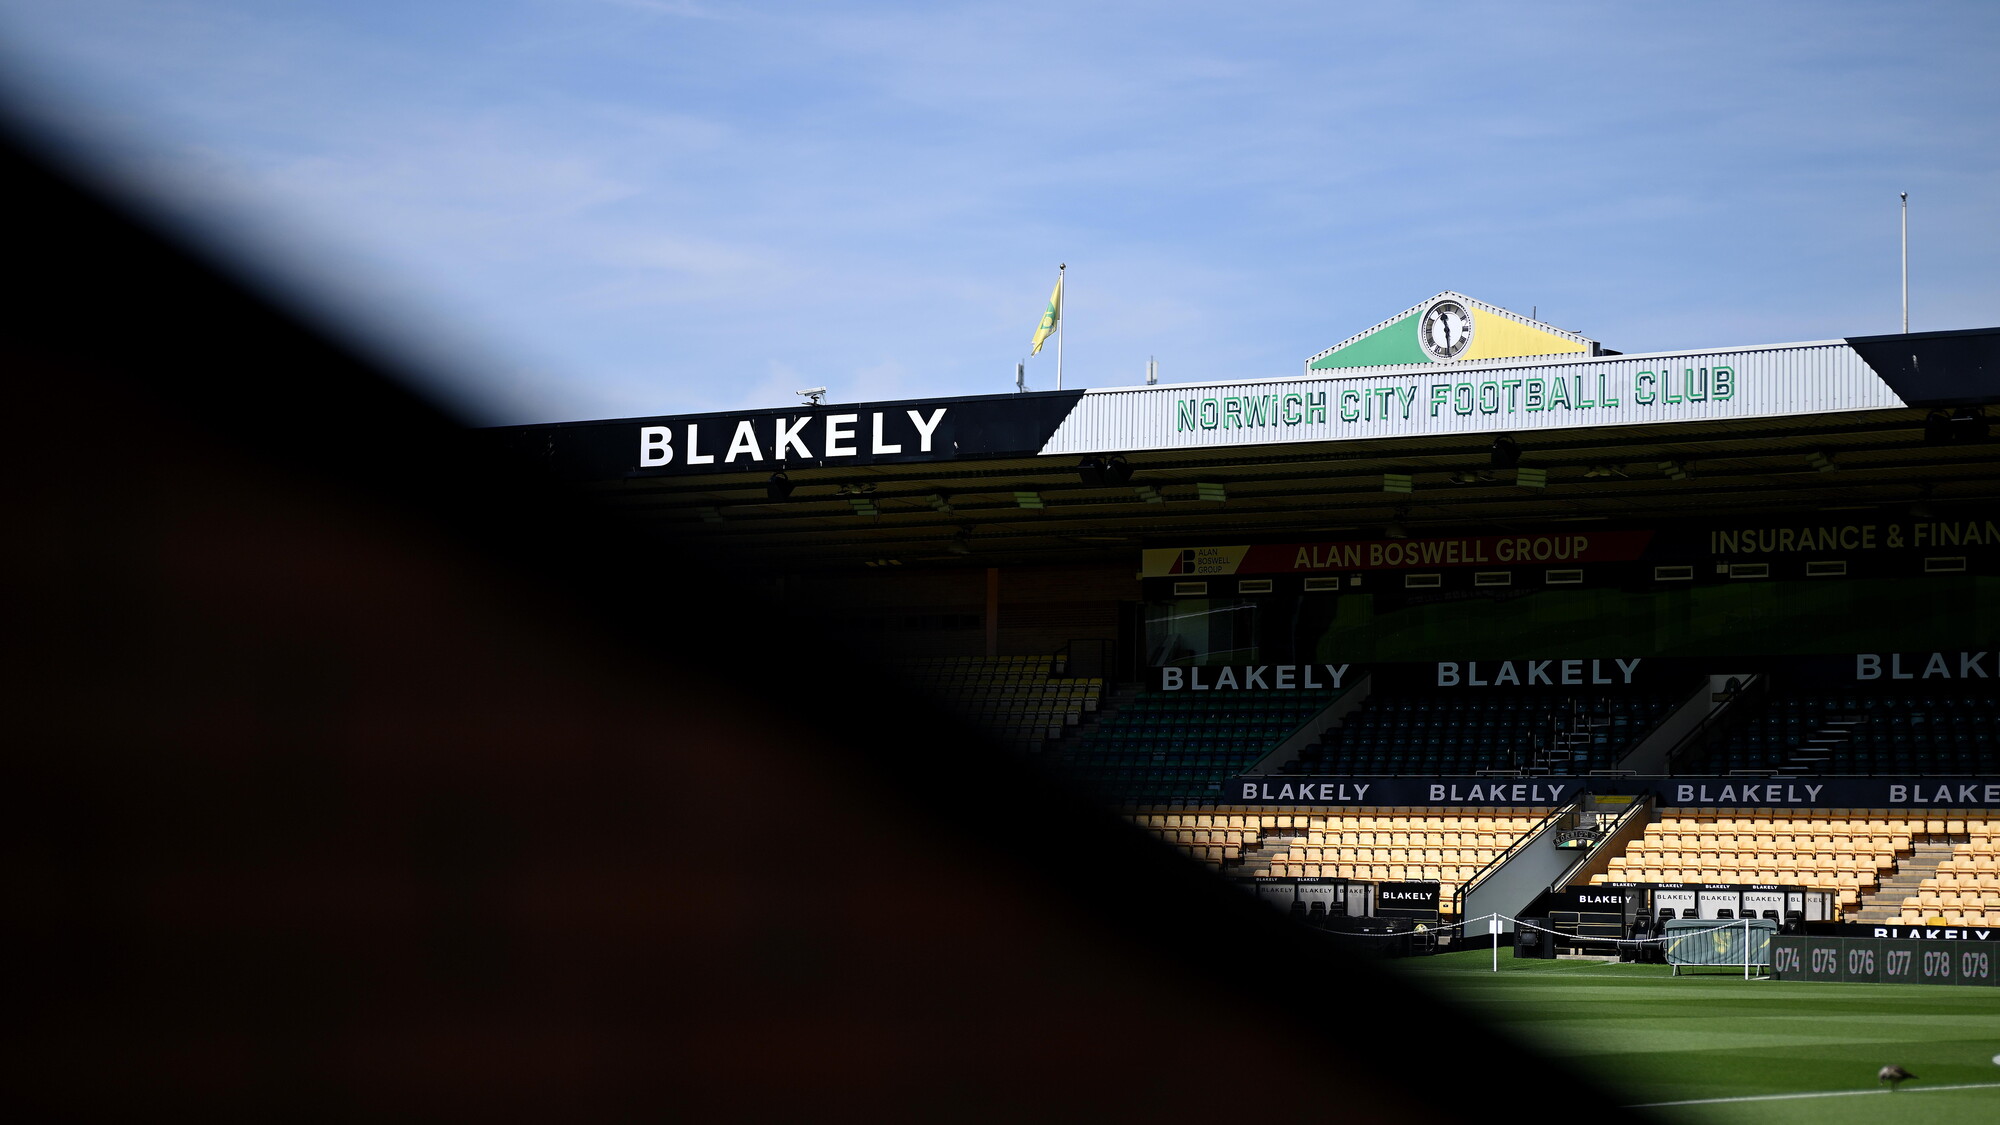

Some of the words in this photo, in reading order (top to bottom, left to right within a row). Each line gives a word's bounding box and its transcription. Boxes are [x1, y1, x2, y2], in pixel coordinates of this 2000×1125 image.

[1431, 373, 1619, 417] FOOTBALL
[1635, 366, 1735, 405] CLUB
[639, 407, 948, 468] BLAKELY
[1711, 524, 1877, 555] INSURANCE
[1886, 523, 1905, 548] &
[1913, 520, 2000, 548] FINAN
[1197, 557, 1231, 565] BOSWELL
[1198, 548, 1218, 556] ALAN
[1293, 544, 1362, 569] ALAN
[1369, 539, 1489, 567] BOSWELL
[1495, 535, 1589, 562] GROUP
[1197, 565, 1223, 573] GROUP
[1162, 663, 1350, 691] BLAKELY
[1436, 657, 1642, 687] BLAKELY
[1856, 651, 2000, 680] BLAK
[1241, 783, 1371, 802] BLAKELY
[1429, 784, 1566, 802] BLAKELY
[1676, 784, 1824, 803] BLAKELY
[1889, 784, 2000, 803] BLAKE
[1382, 891, 1433, 901] BLAKELY
[1775, 947, 1800, 972] 074
[1812, 948, 1837, 974] 075
[1849, 949, 1874, 975] 076
[1887, 951, 1912, 976] 077
[1924, 951, 1950, 977] 078
[1962, 952, 1989, 978] 079
